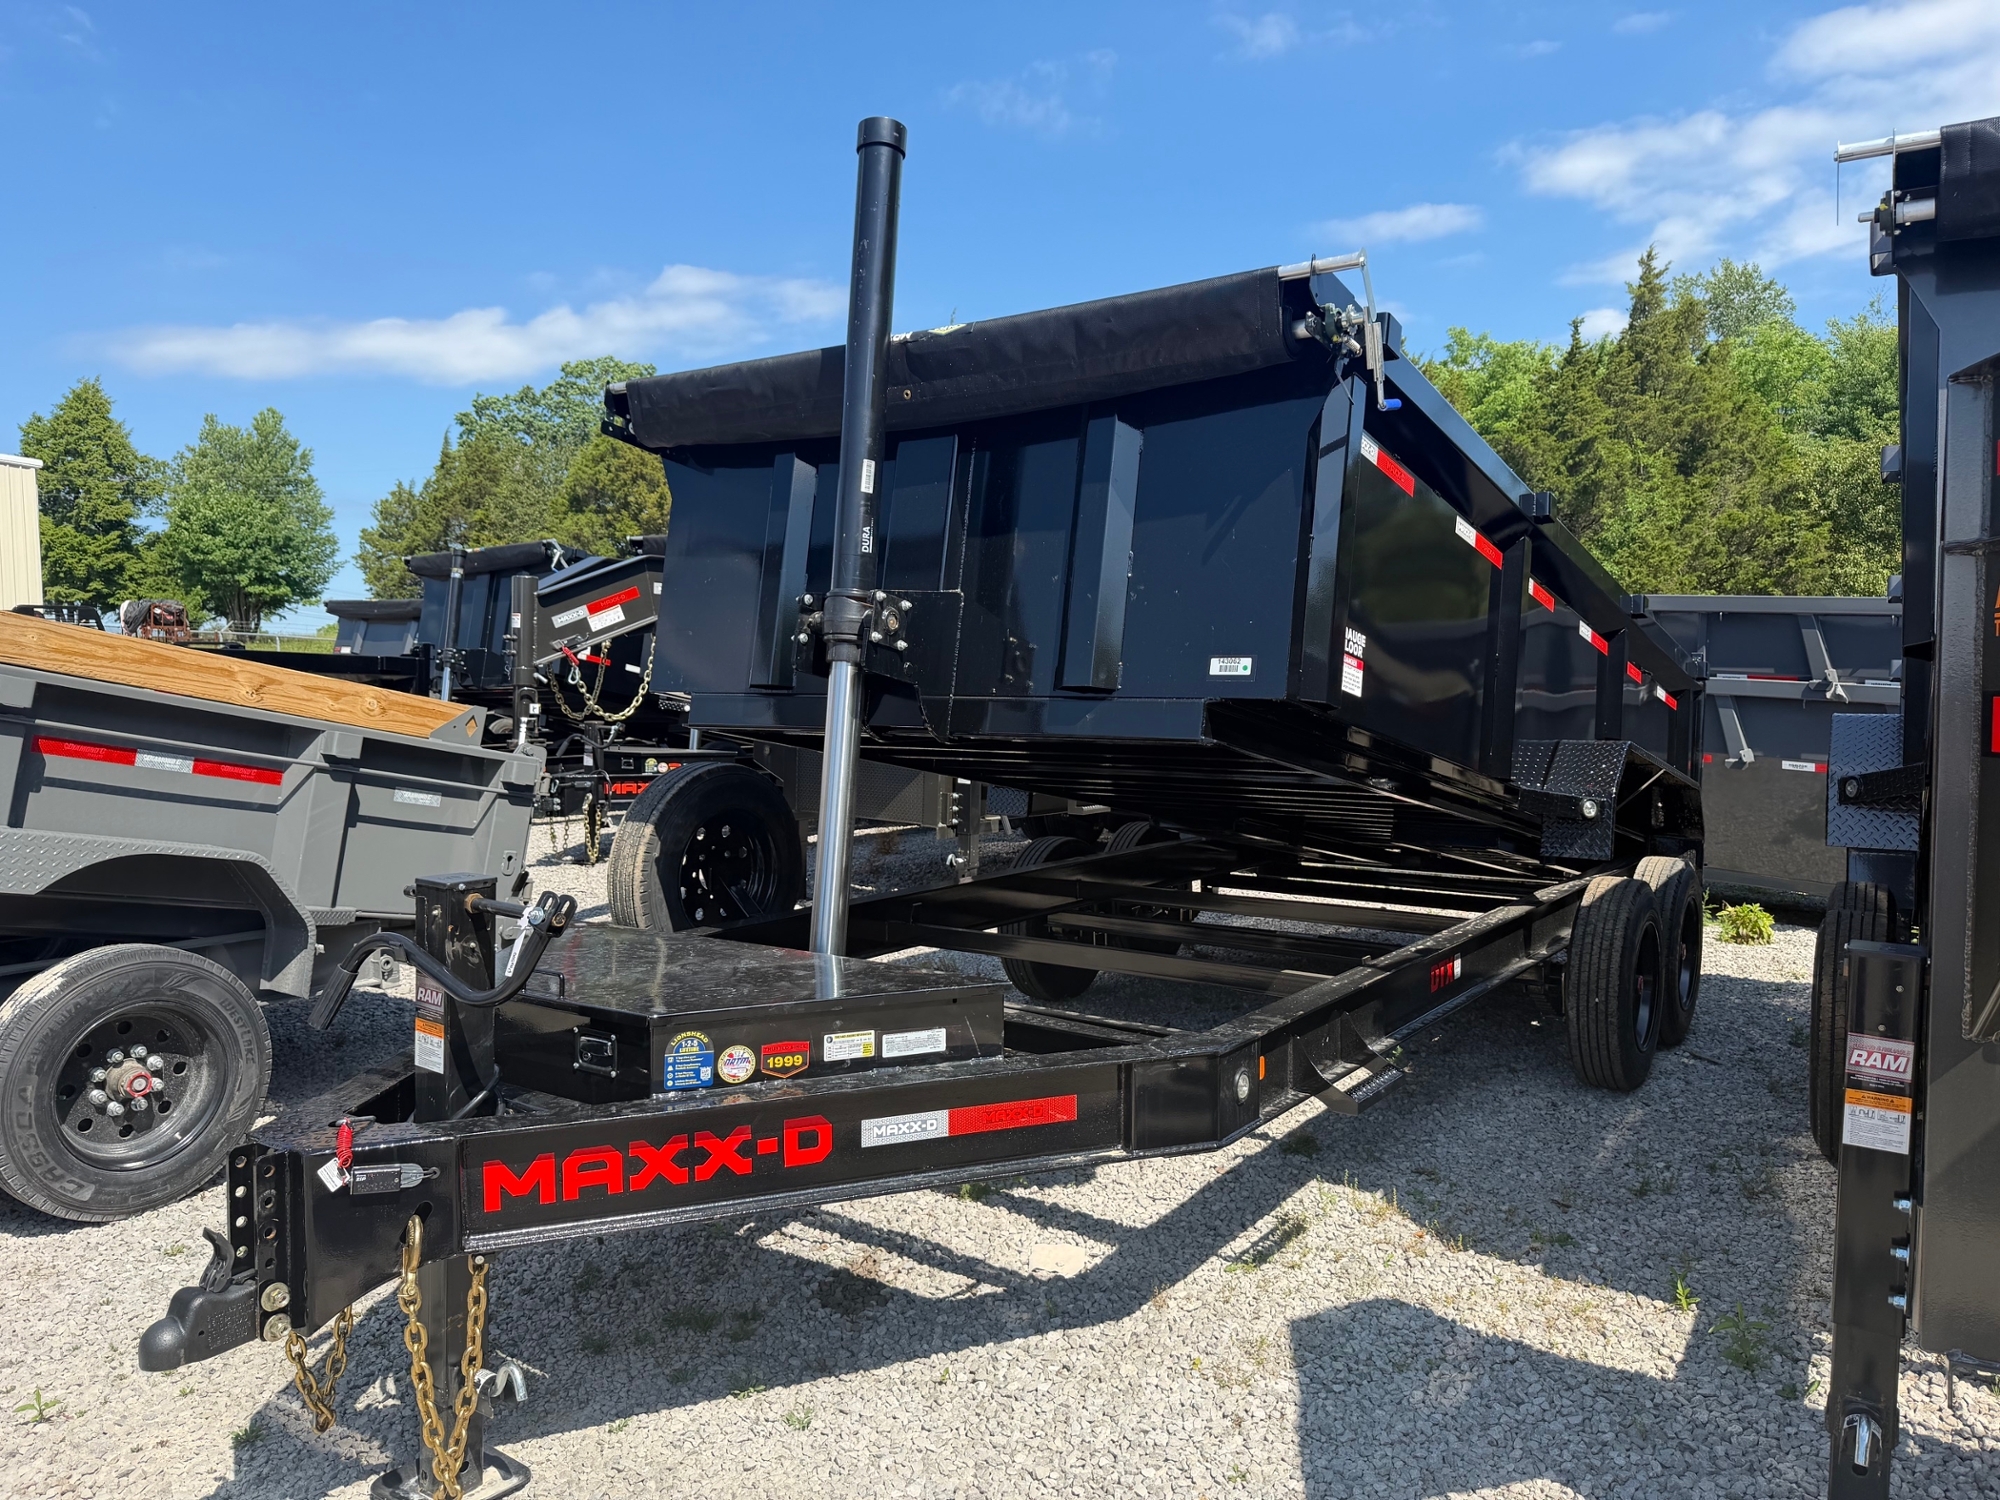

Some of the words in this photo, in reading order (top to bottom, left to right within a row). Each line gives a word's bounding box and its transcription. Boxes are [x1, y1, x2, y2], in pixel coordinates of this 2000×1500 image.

[862, 526, 870, 553] DURA
[1345, 626, 1367, 648] AUGE
[1344, 638, 1364, 659] LOOR
[417, 987, 443, 1006] RAM
[219, 998, 256, 1065] WESTLAKE
[670, 1031, 709, 1046] LIONSHEAD
[766, 1055, 803, 1068] 1999
[1849, 1049, 1908, 1072] RAM
[1866, 1095, 1890, 1103] WARNING
[982, 1106, 1044, 1123] MAXX-D
[873, 1119, 938, 1139] MAXX-D
[483, 1115, 833, 1213] MAXX-D
